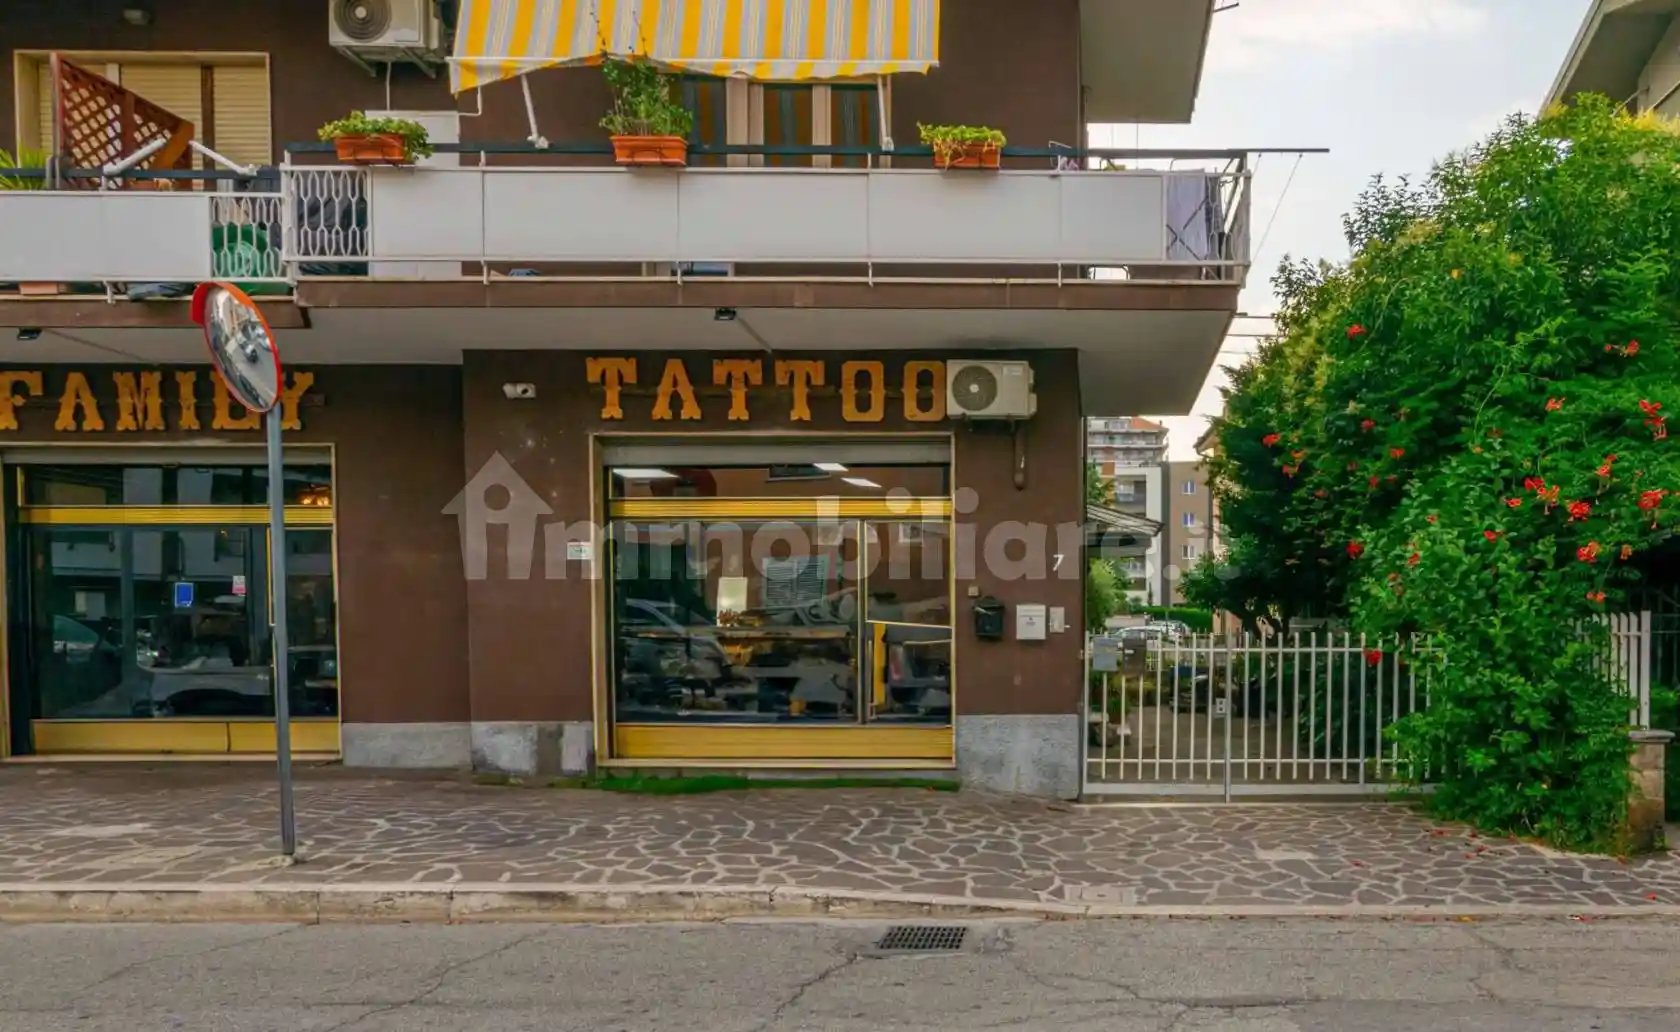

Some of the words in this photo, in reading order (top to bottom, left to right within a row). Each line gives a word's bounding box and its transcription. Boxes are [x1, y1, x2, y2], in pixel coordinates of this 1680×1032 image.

[0, 371, 314, 431] FAMILY
[585, 358, 946, 423] TATTOO
[1053, 554, 1065, 572] 7
